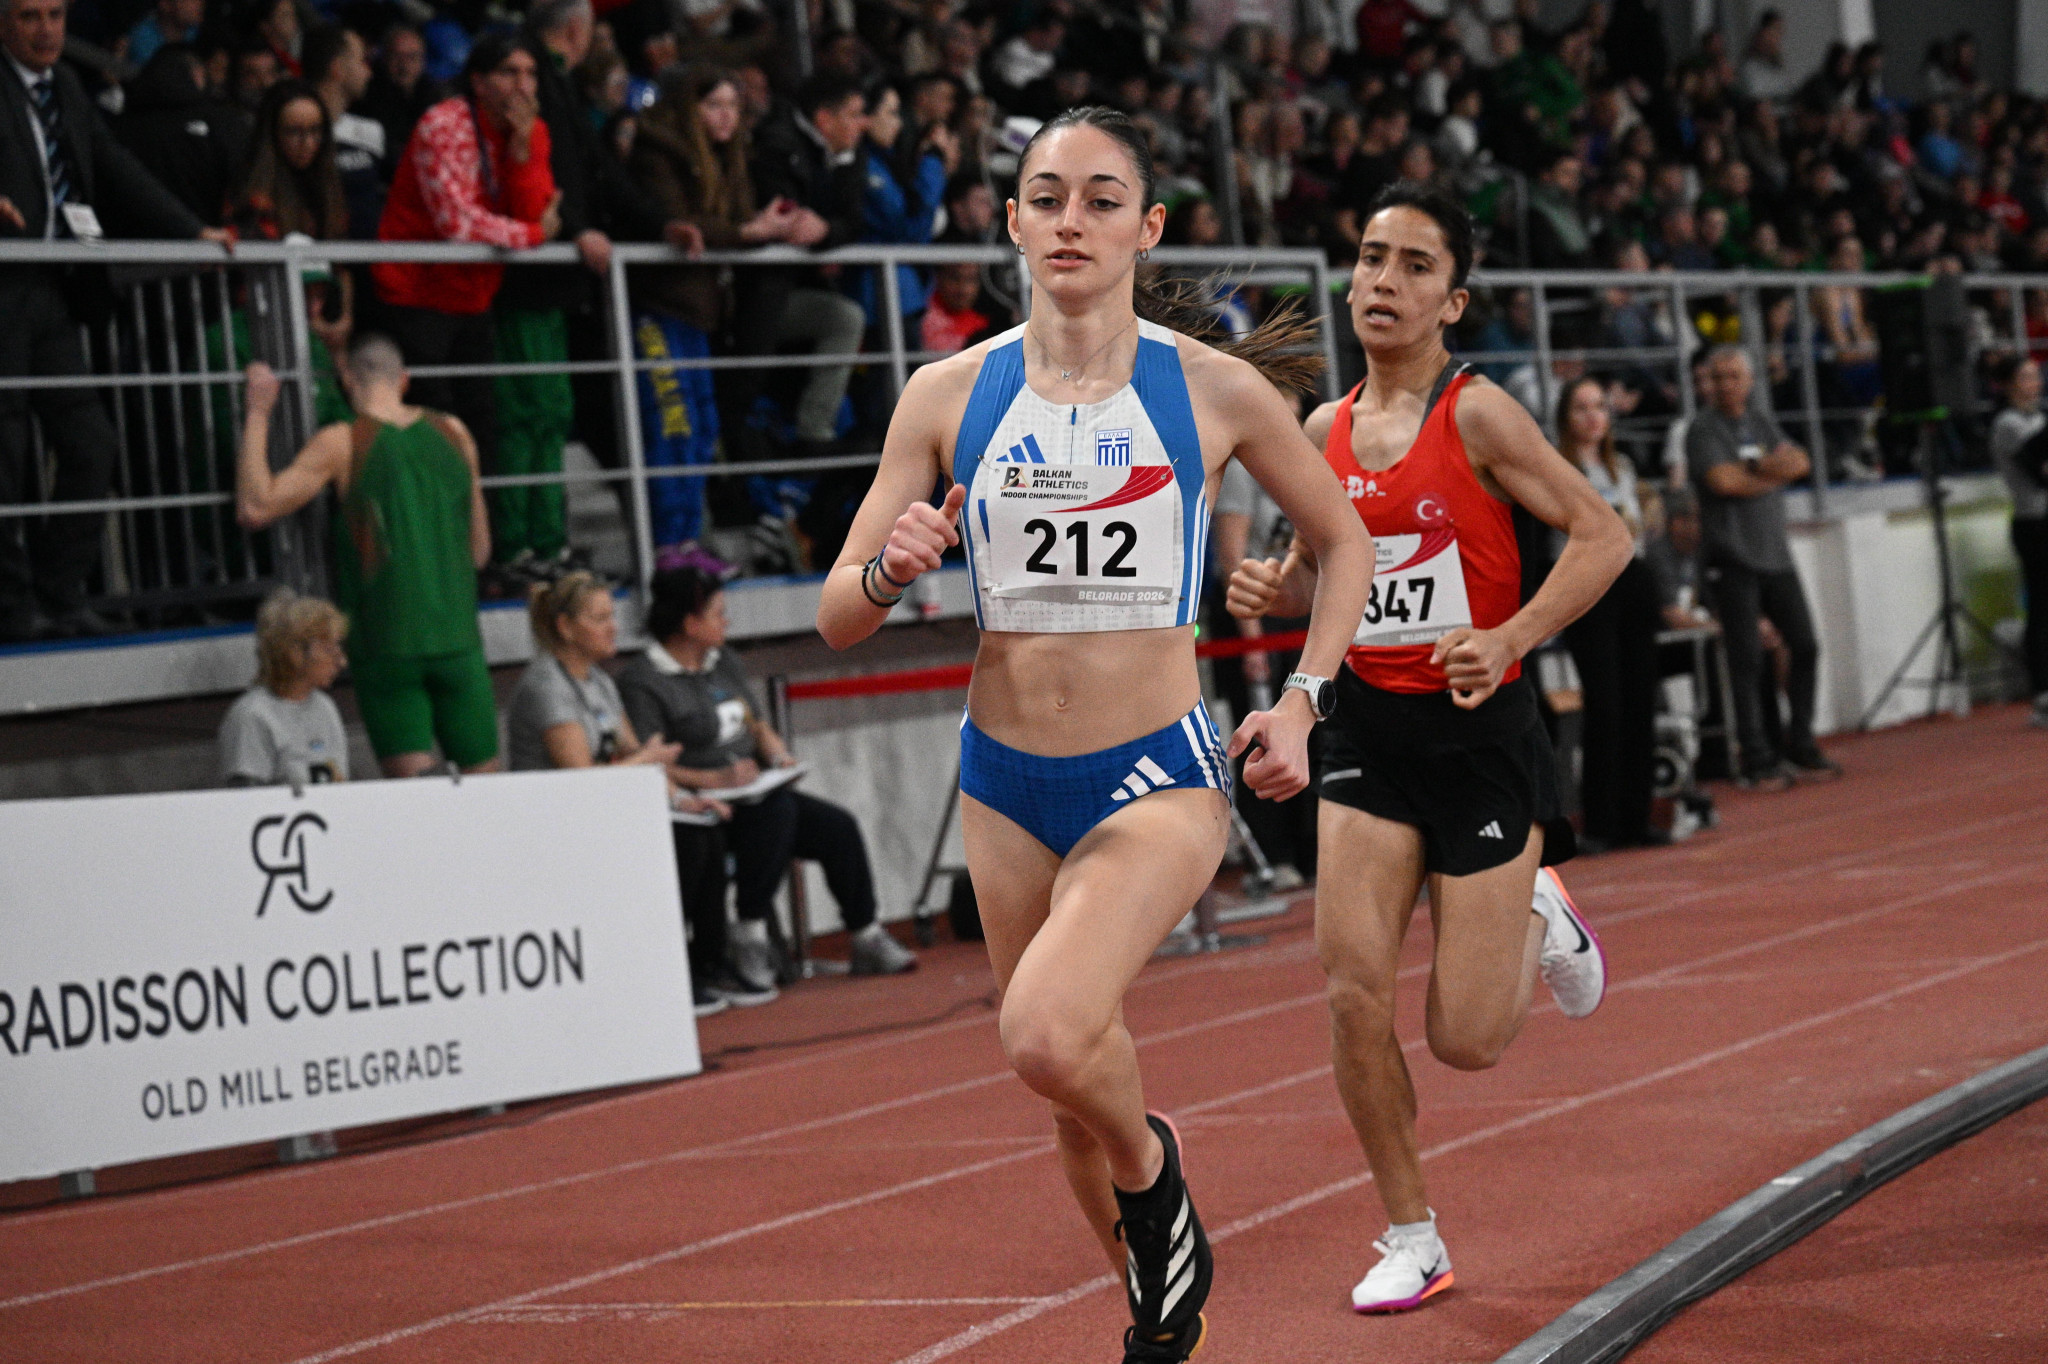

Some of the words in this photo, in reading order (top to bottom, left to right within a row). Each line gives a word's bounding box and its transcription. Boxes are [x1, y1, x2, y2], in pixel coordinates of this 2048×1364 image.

[1032, 469, 1072, 479] BALKAN
[1032, 480, 1088, 490] ATHLETICS
[1000, 491, 1027, 499] INDOOR
[1028, 493, 1088, 501] CHAMPIONSHIPS
[1023, 518, 1137, 577] 212
[1136, 591, 1165, 601] 2026
[1364, 577, 1435, 624] 347
[0, 963, 248, 1055] RADISSON
[265, 927, 585, 1021] COLLECTION
[141, 1077, 208, 1121] OLD
[220, 1065, 293, 1109] MILL
[303, 1041, 463, 1097] BELGRADE
